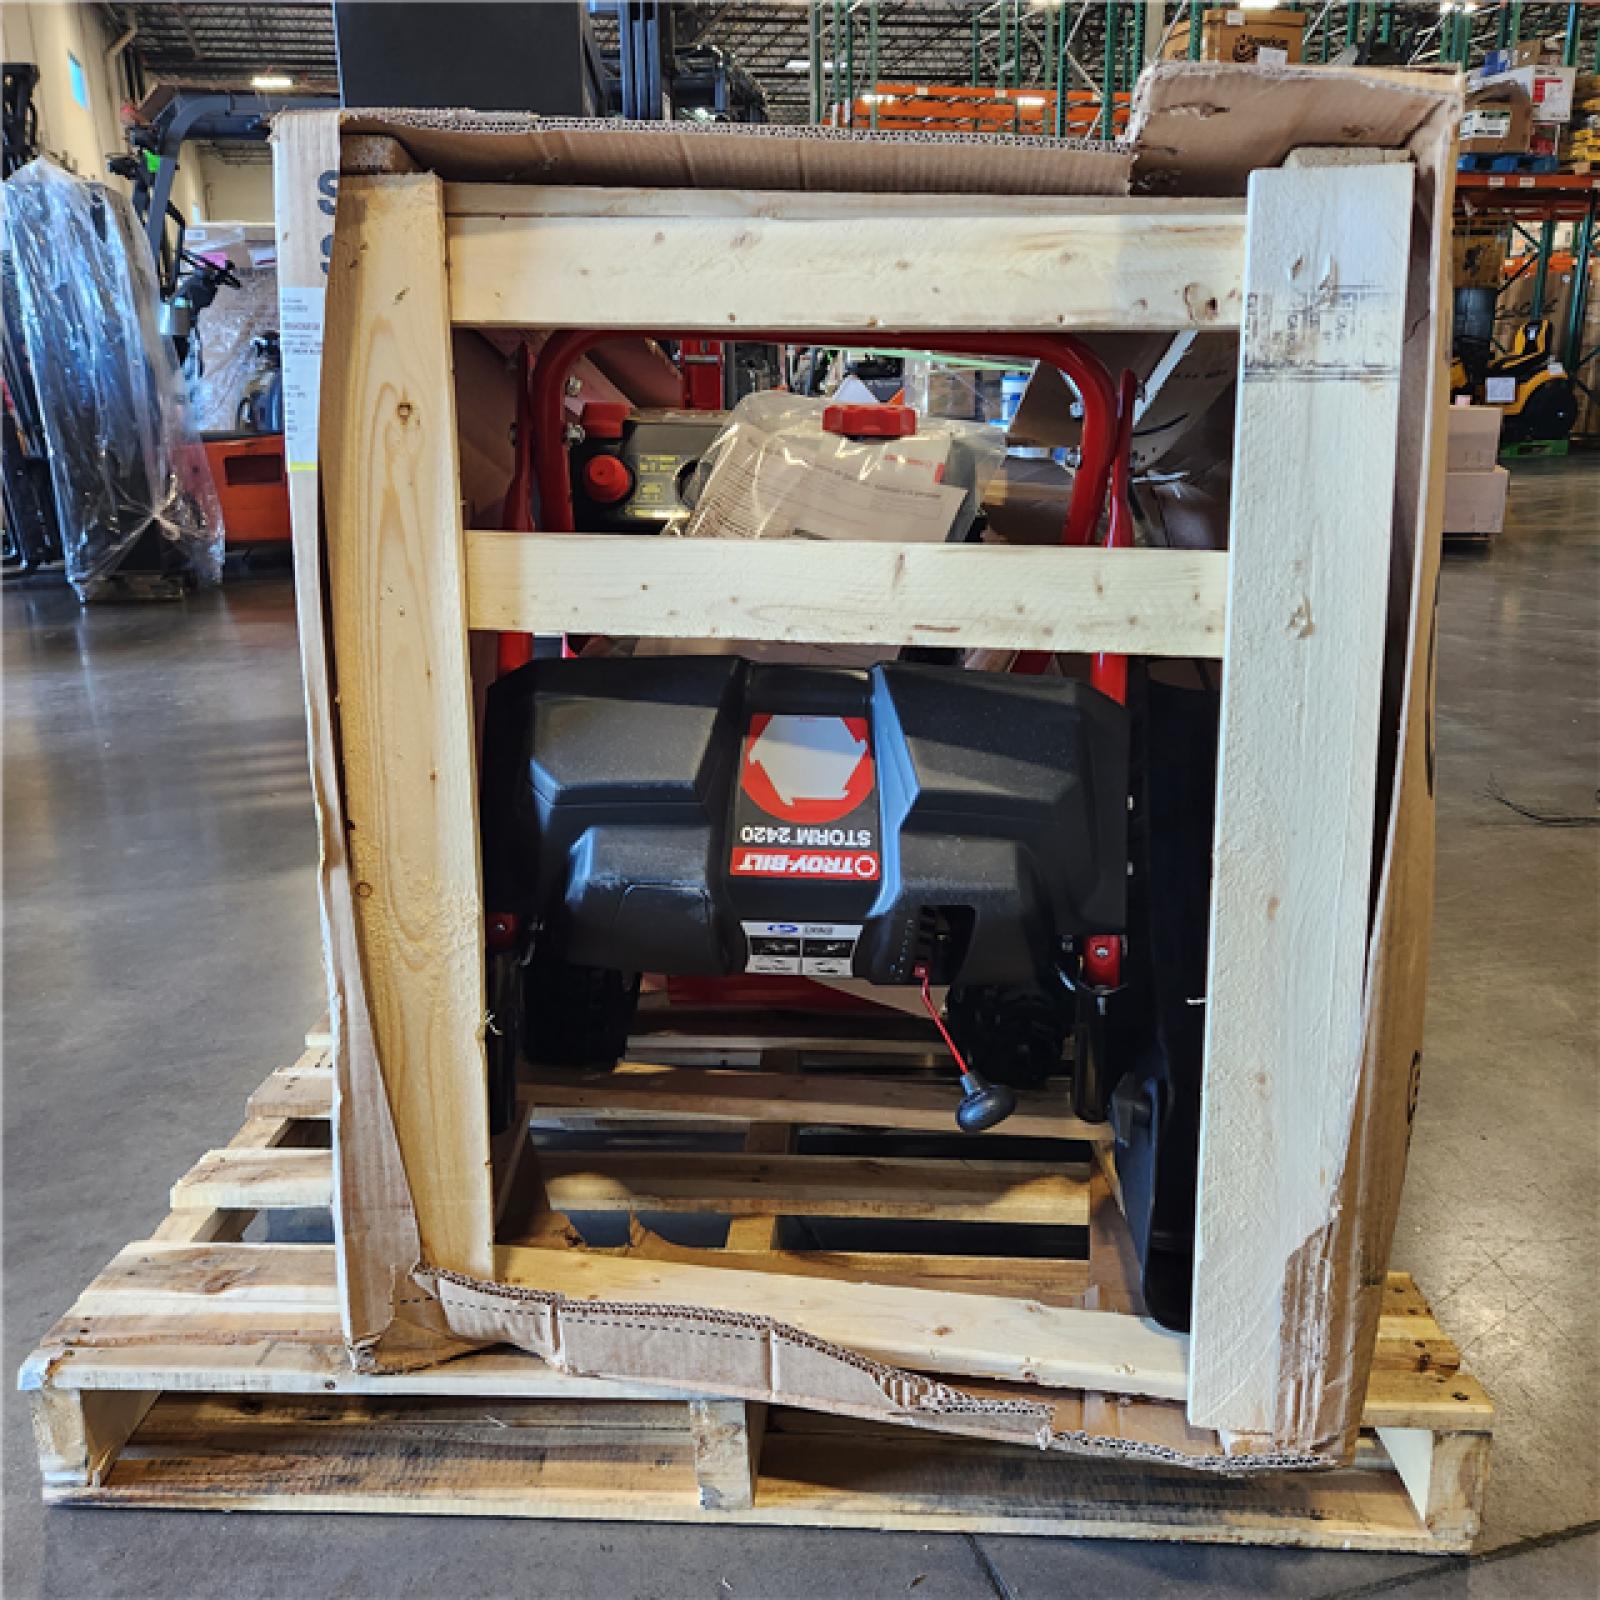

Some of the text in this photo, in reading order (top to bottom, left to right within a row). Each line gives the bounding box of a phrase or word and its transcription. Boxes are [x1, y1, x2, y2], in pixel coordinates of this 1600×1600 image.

[740, 825, 871, 847] STORM 2420
[736, 853, 854, 874] TROY-BILT
